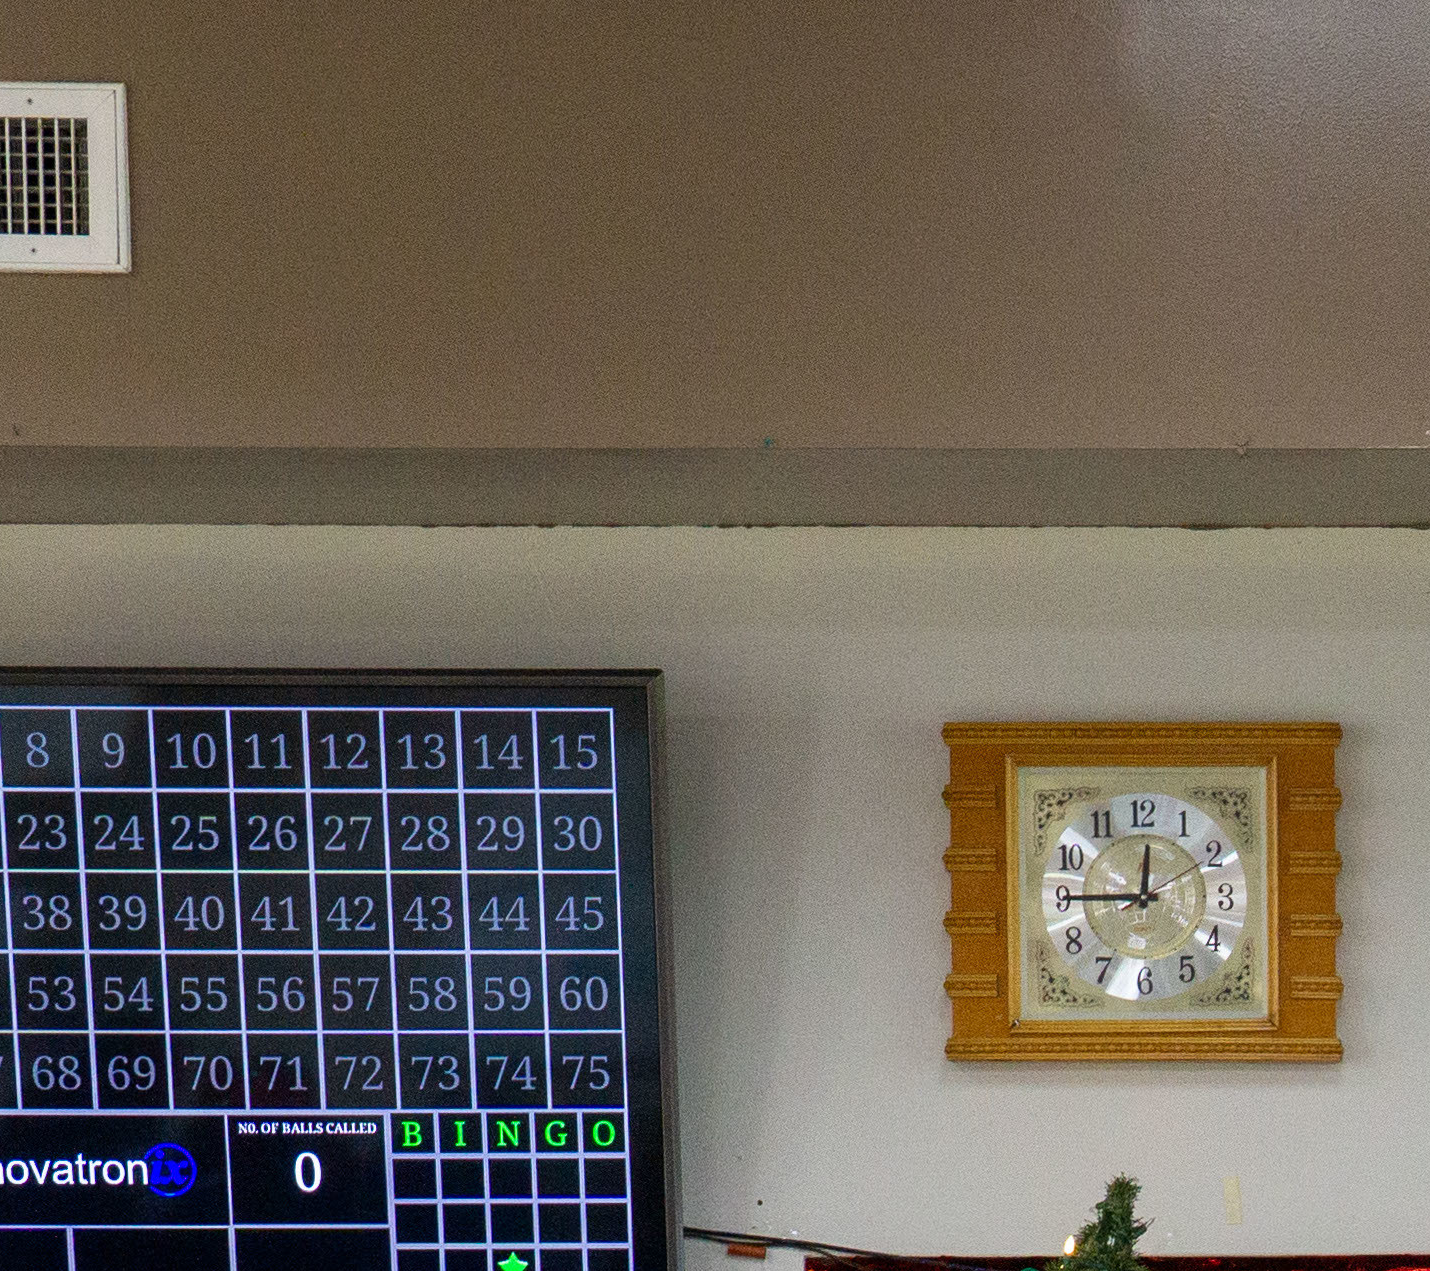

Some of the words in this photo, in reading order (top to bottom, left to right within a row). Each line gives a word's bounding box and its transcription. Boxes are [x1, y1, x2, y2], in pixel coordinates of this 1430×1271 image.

[24, 730, 51, 769] 8
[100, 731, 126, 770] 9
[167, 732, 217, 770] 10
[244, 732, 291, 770] 11
[320, 732, 370, 770] 12
[397, 733, 447, 771] 13
[473, 733, 524, 771] 14
[550, 733, 599, 771] 15
[1091, 809, 1114, 839] 11
[1131, 799, 1156, 828] 12
[1177, 810, 1191, 838] 1
[16, 814, 68, 851] 23
[93, 814, 145, 851] 24
[170, 814, 220, 851] 25
[247, 814, 298, 852] 26
[323, 815, 373, 852] 27
[400, 814, 452, 852] 28
[475, 814, 527, 853] 29
[552, 814, 604, 852] 30
[1057, 843, 1084, 872] 10
[1206, 840, 1223, 868] 2
[1055, 885, 1071, 912] 9
[1217, 883, 1234, 911] 3
[21, 893, 73, 931] 38
[98, 893, 148, 931] 39
[173, 894, 226, 932] 40
[250, 895, 300, 932] 41
[326, 895, 377, 932] 42
[402, 895, 455, 932] 43
[477, 894, 531, 933] 44
[553, 894, 606, 933] 45
[1064, 927, 1083, 955] 8
[1205, 924, 1222, 952] 4
[1094, 956, 1113, 984] 7
[1136, 967, 1154, 995] 6
[1178, 956, 1196, 983] 5
[27, 975, 77, 1012] 53
[103, 975, 154, 1012] 54
[180, 975, 229, 1013] 55
[256, 975, 307, 1013] 56
[331, 976, 381, 1012] 57
[408, 975, 459, 1013] 58
[483, 974, 534, 1013] 59
[558, 974, 610, 1013] 60
[31, 1054, 82, 1091] 68
[107, 1055, 157, 1091] 69
[182, 1054, 234, 1091] 70
[259, 1054, 307, 1091] 71
[334, 1054, 385, 1091] 72
[410, 1054, 461, 1091] 73
[485, 1054, 537, 1091] 74
[561, 1054, 611, 1091] 75
[238, 1121, 259, 1135] NO.
[261, 1121, 280, 1135] OF
[282, 1121, 324, 1135] BALLS
[326, 1121, 377, 1135] CALLED
[400, 1119, 424, 1148] B
[453, 1119, 467, 1148] I
[495, 1119, 522, 1148] N
[543, 1119, 569, 1148] G
[591, 1118, 617, 1148] O
[295, 1151, 322, 1193] 0
